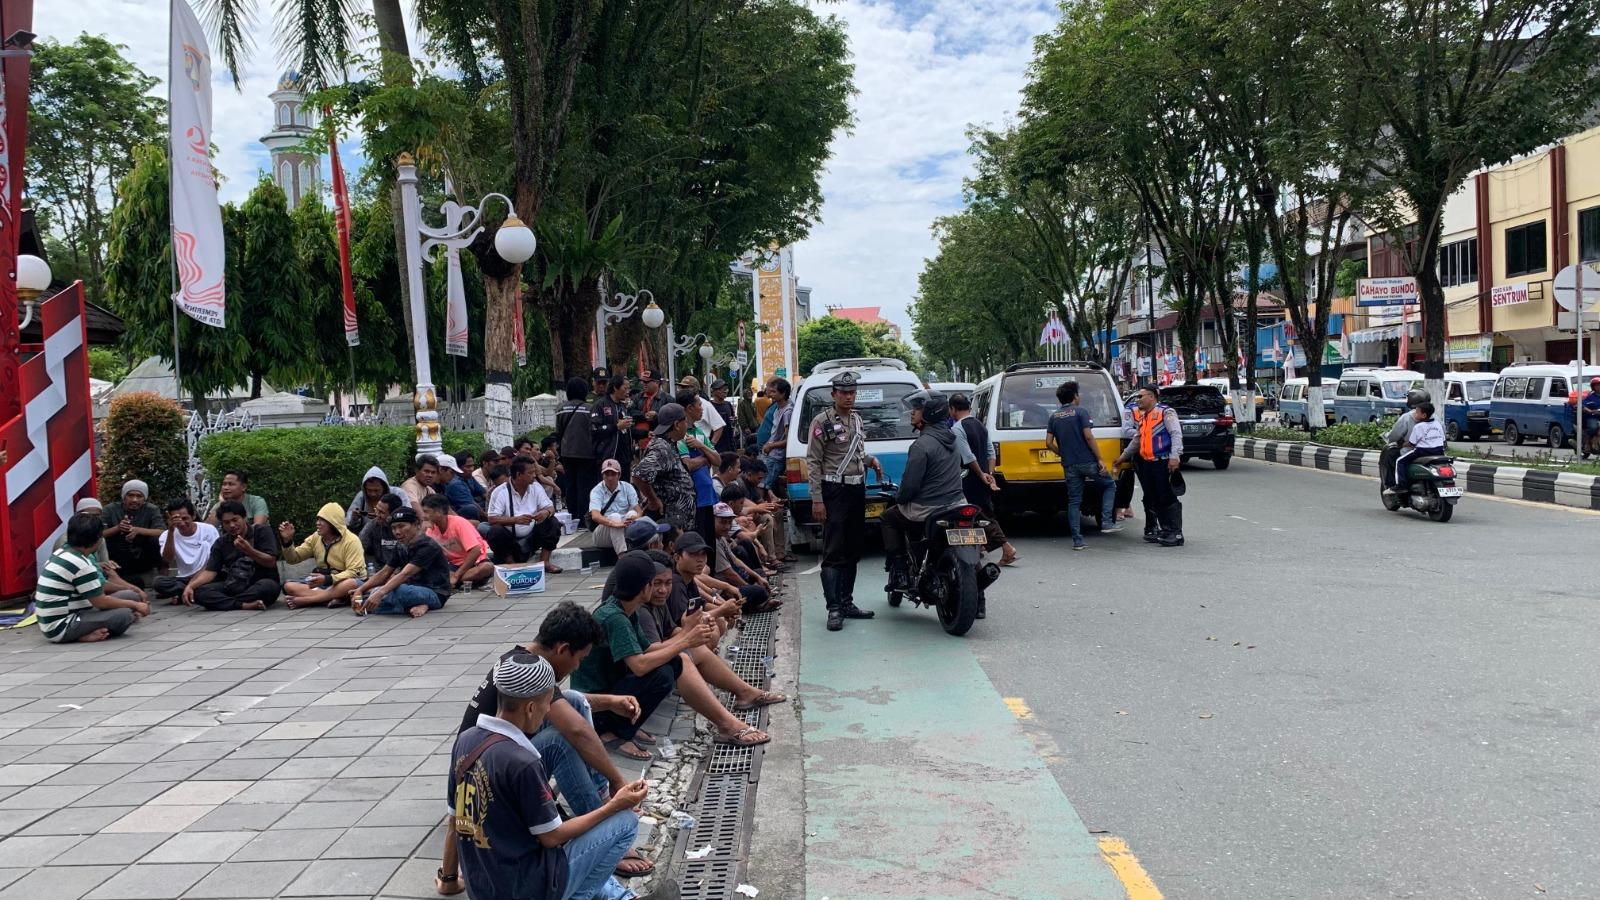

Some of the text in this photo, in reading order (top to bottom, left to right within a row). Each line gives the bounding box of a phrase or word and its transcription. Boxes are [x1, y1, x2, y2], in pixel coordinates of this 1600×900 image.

[1360, 282, 1415, 296] CAHAYO BUNDO
[1492, 289, 1528, 306] SENTRUM
[1036, 377, 1043, 388] 5
[456, 781, 476, 818] 15
